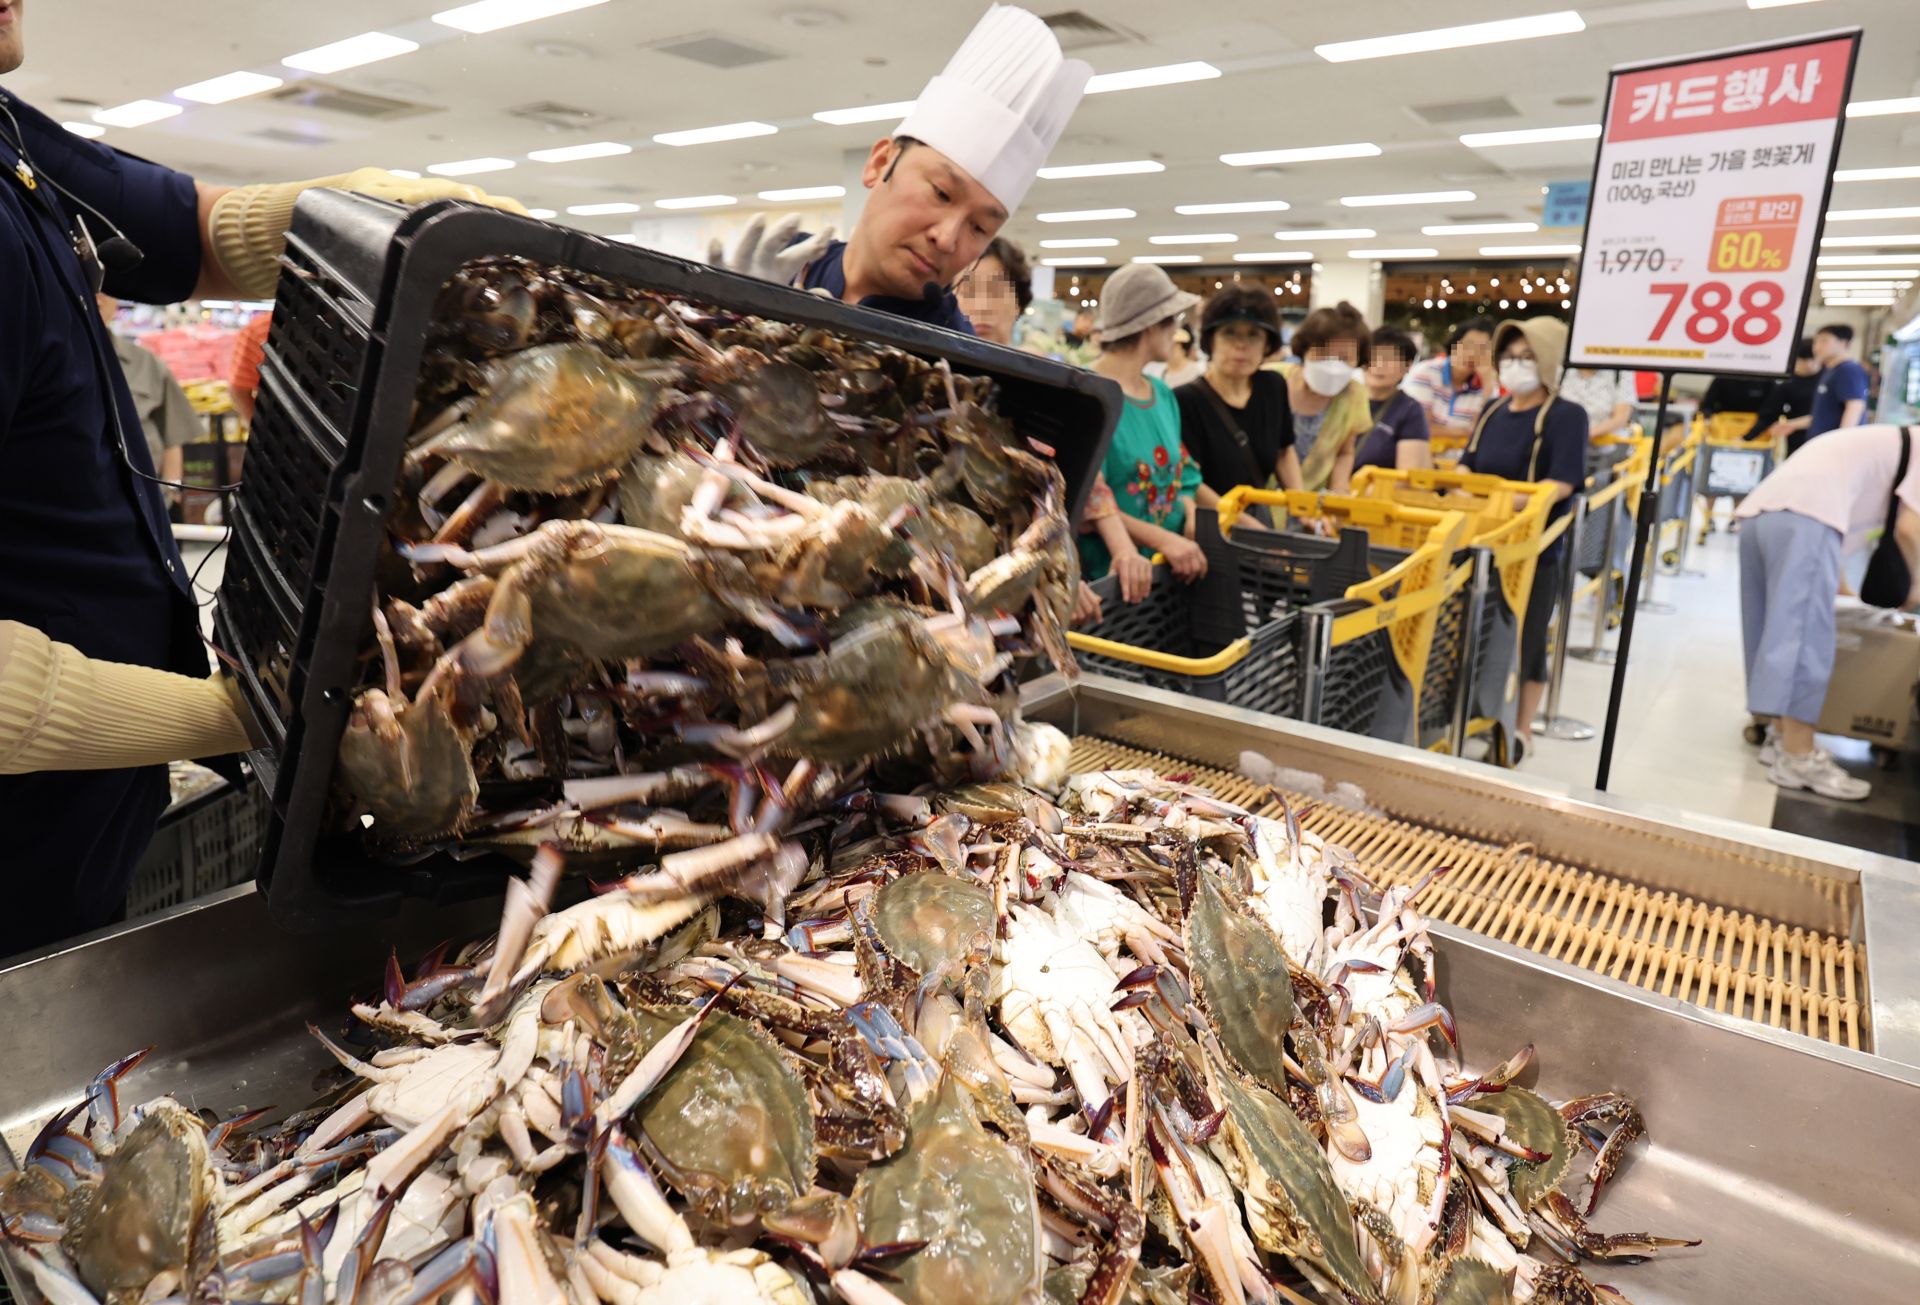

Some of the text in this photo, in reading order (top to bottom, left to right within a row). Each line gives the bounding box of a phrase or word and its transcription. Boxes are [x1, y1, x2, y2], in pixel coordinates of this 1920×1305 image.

[1629, 60, 1821, 123] 카드행사
[1612, 143, 1815, 180] 미리 만나는 가을 햇꽃게
[1759, 200, 1796, 221] 할인
[1599, 248, 1665, 274] 1,970
[1718, 232, 1782, 269] 60%
[1648, 281, 1785, 345] 788
